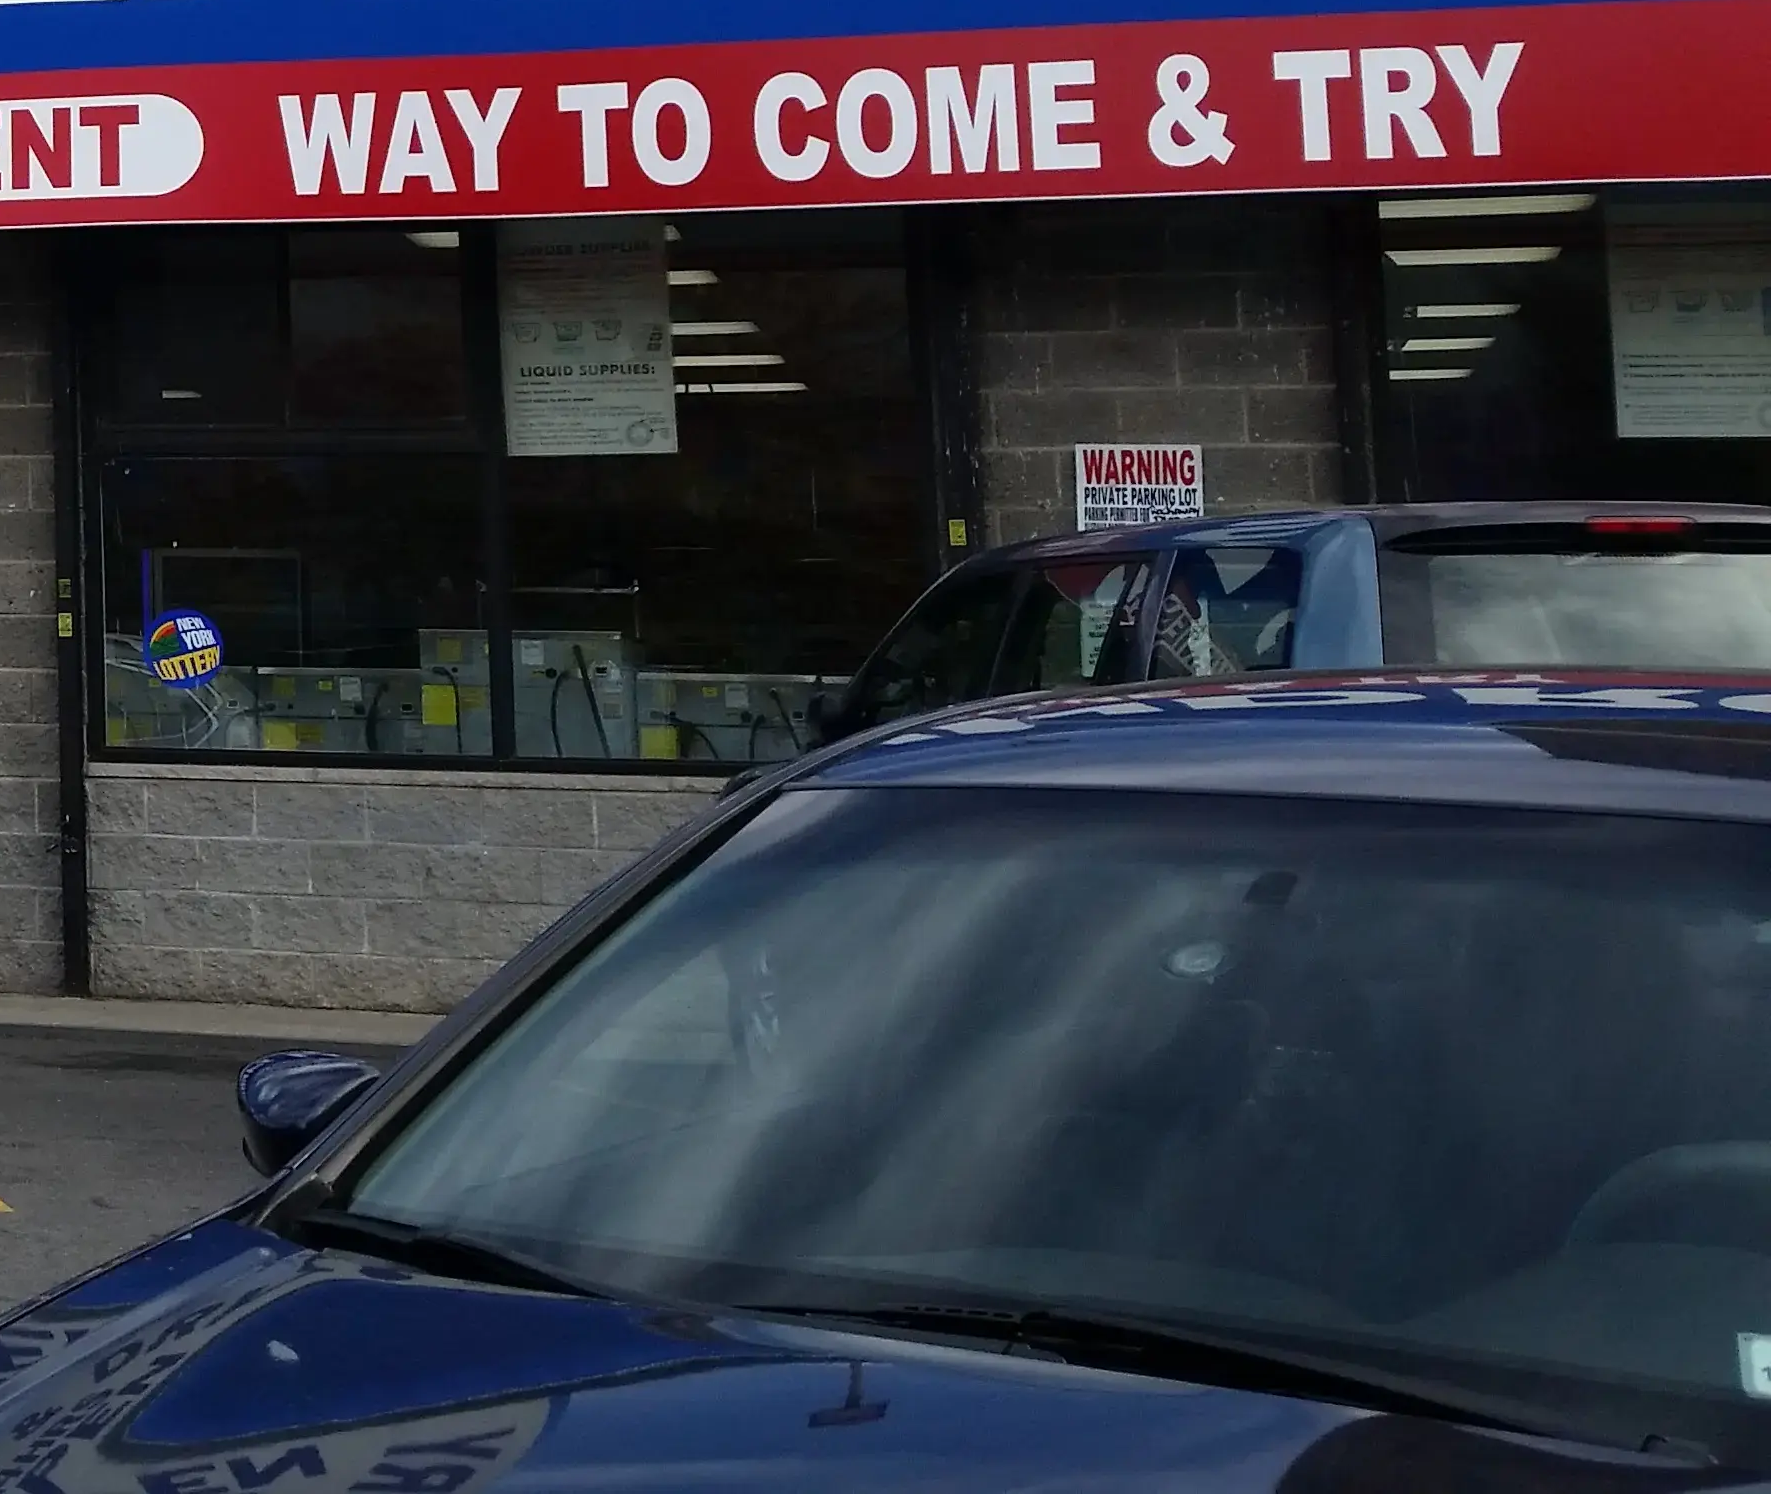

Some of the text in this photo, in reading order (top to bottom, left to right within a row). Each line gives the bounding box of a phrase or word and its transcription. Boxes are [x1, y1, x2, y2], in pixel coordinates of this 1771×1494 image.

[277, 86, 523, 196] WAY
[558, 78, 712, 187] TO
[754, 58, 1102, 183] COME
[1147, 54, 1235, 168] &
[1273, 41, 1526, 163] TRY
[520, 365, 574, 378] LIQUID
[1082, 449, 1196, 486] WARNING
[1084, 487, 1198, 507] PRIVATE PARKING LOT
[175, 616, 206, 632] NEW
[180, 628, 217, 651] YORK
[152, 644, 221, 681] LOTTERY
